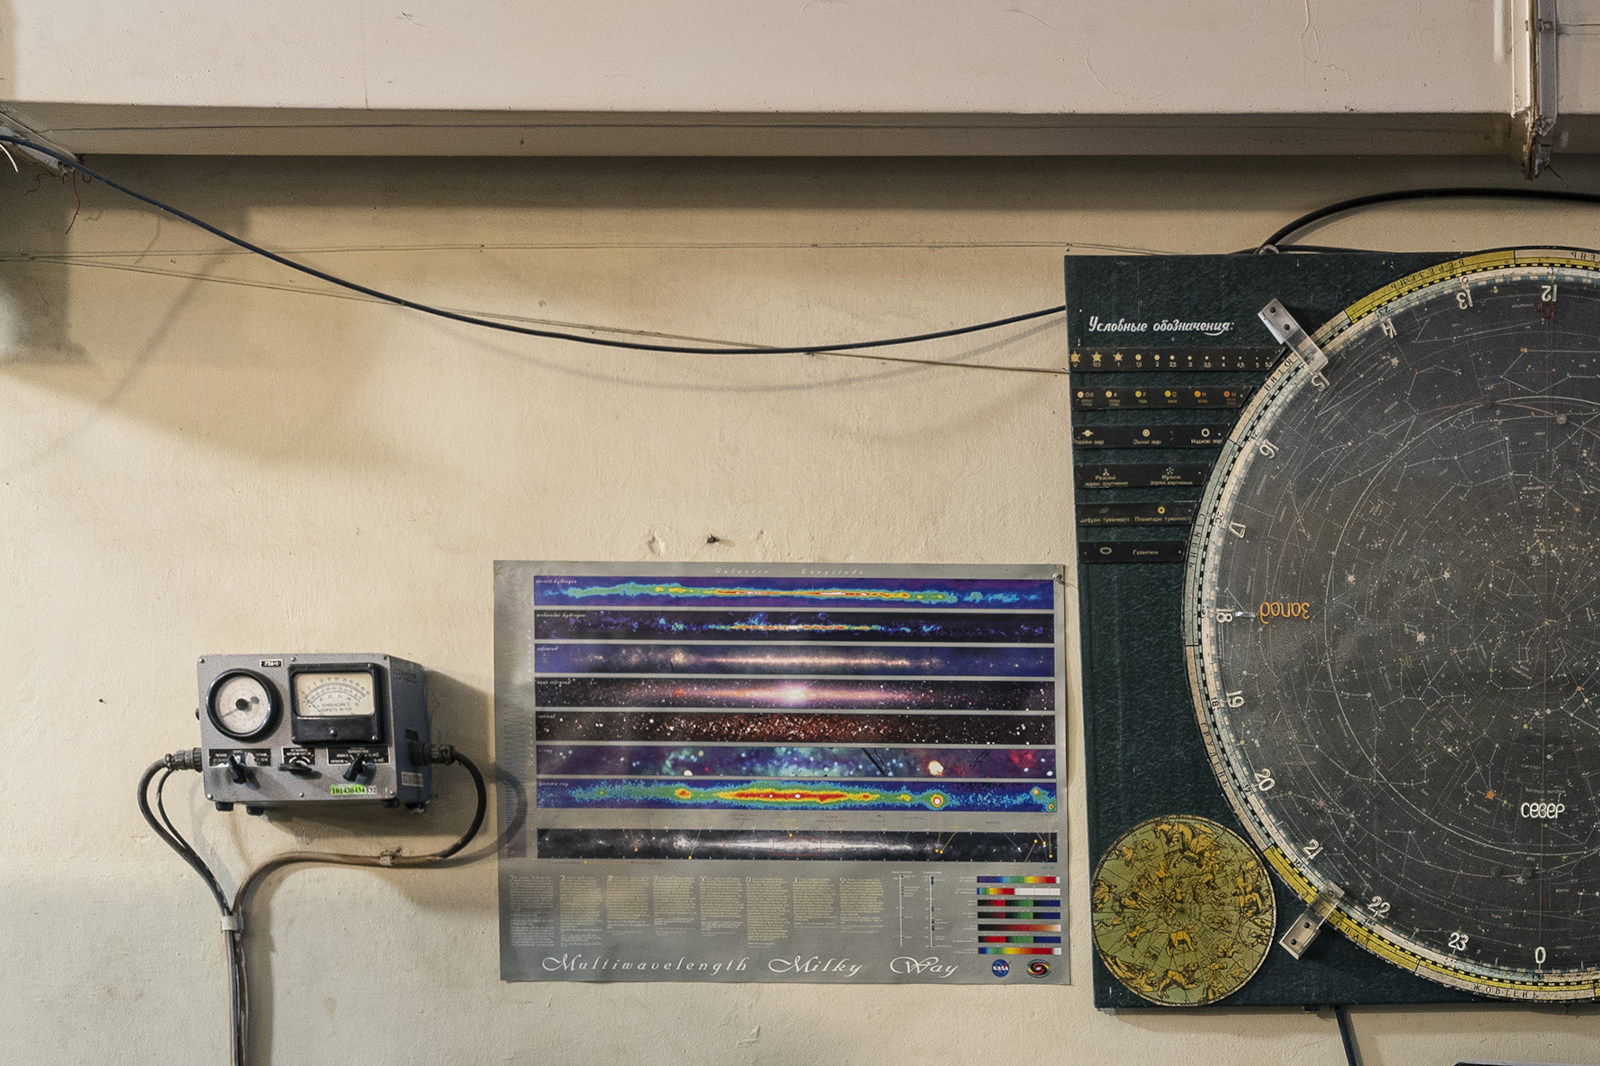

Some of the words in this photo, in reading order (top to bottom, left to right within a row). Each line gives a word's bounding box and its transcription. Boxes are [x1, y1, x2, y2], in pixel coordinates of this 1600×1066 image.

[1455, 288, 1474, 310] 13
[1541, 284, 1558, 302] 12
[1088, 315, 1148, 332] Условные
[1153, 318, 1235, 336] обозначения:
[1311, 371, 1330, 391] 15
[1259, 440, 1280, 459] 16
[1216, 608, 1233, 624] 18
[1259, 601, 1310, 625] Запад
[1225, 690, 1245, 708] 19
[1254, 768, 1275, 792] 20
[1303, 838, 1323, 860] 21
[1367, 895, 1390, 917] 22
[1447, 932, 1469, 951] 23
[1534, 946, 1547, 964] 0
[540, 954, 750, 974] Multiwavelength
[766, 954, 864, 977] Milky
[888, 954, 959, 977] Way
